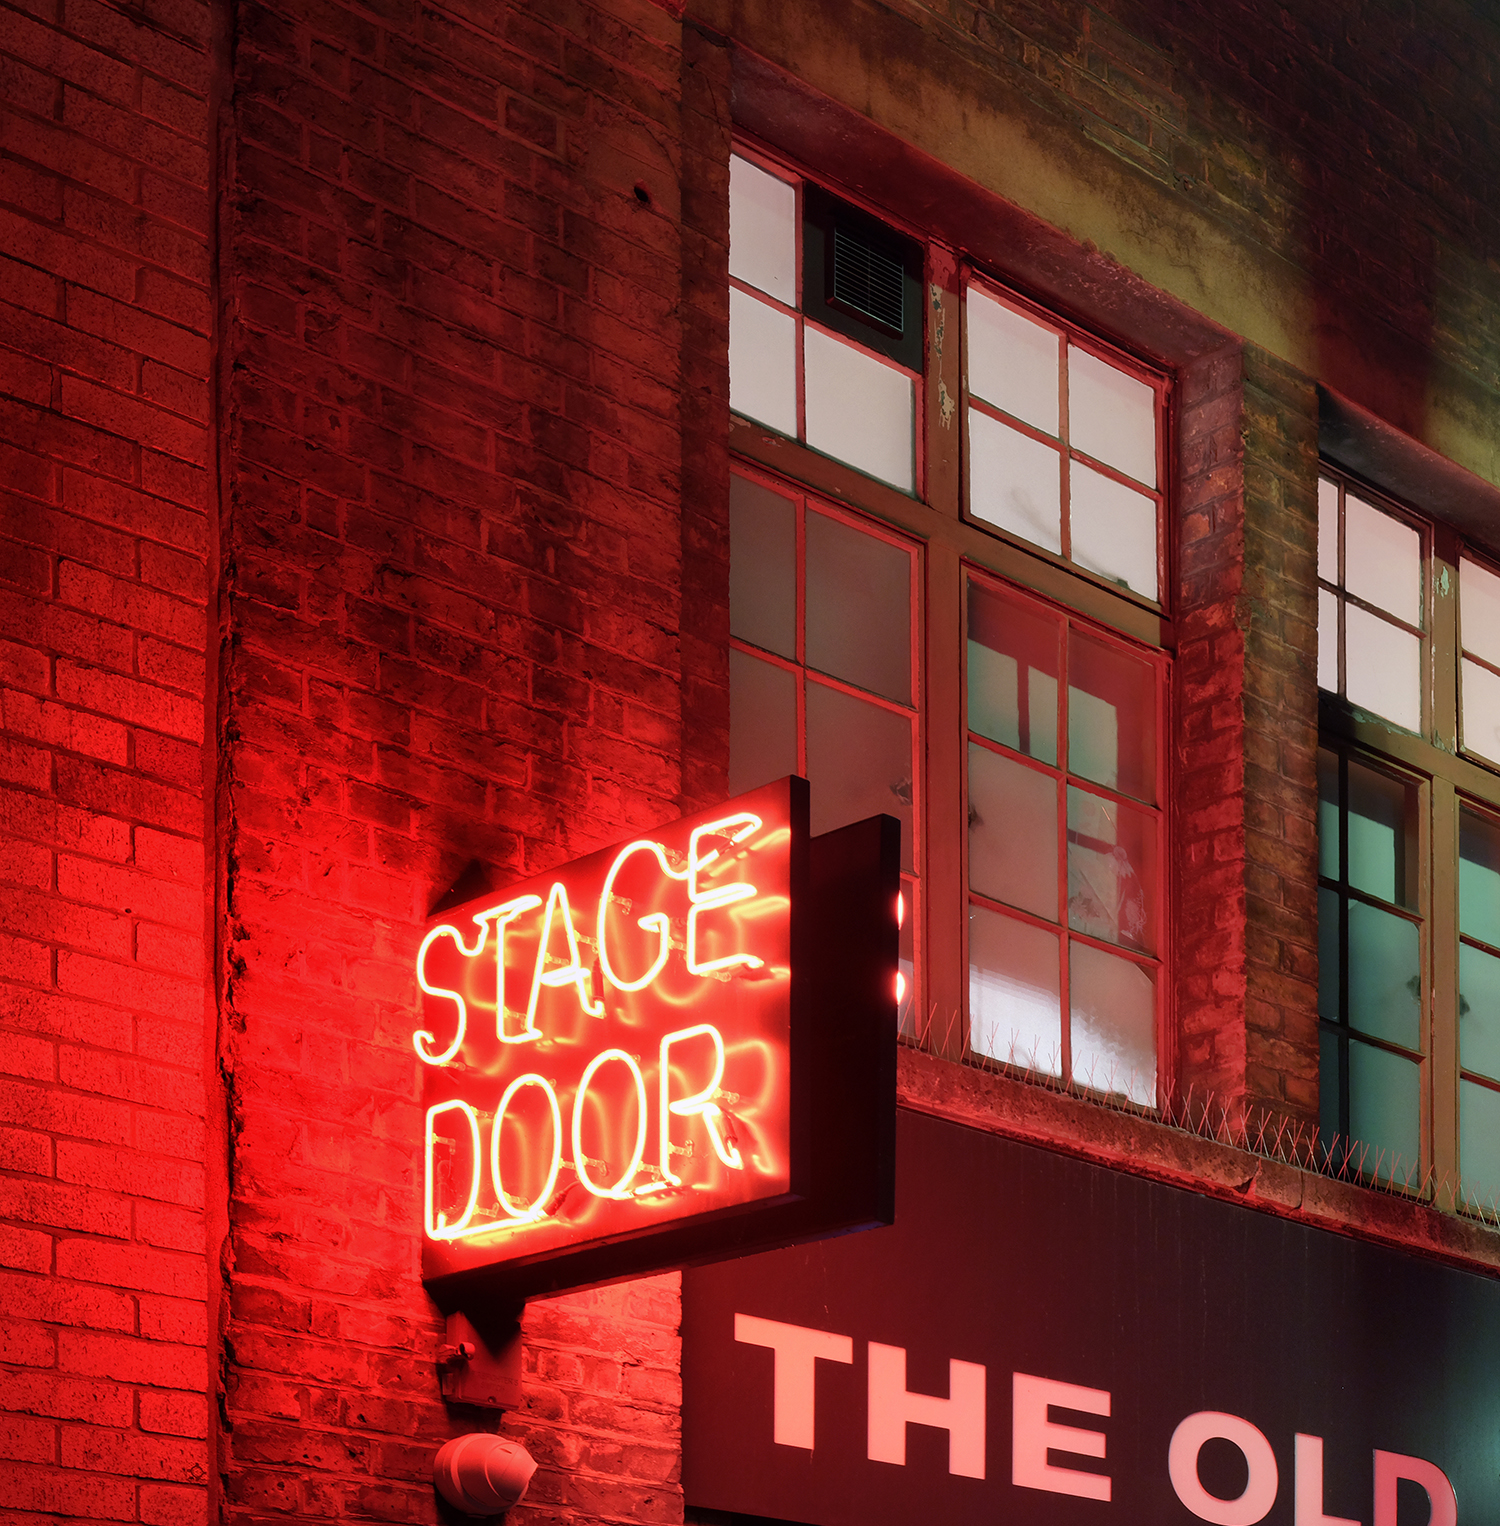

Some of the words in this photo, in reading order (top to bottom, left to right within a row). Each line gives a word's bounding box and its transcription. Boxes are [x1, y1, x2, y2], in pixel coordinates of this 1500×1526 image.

[413, 812, 764, 1065] STAGE
[425, 1023, 744, 1240] DOOR
[734, 1312, 1112, 1503] THE
